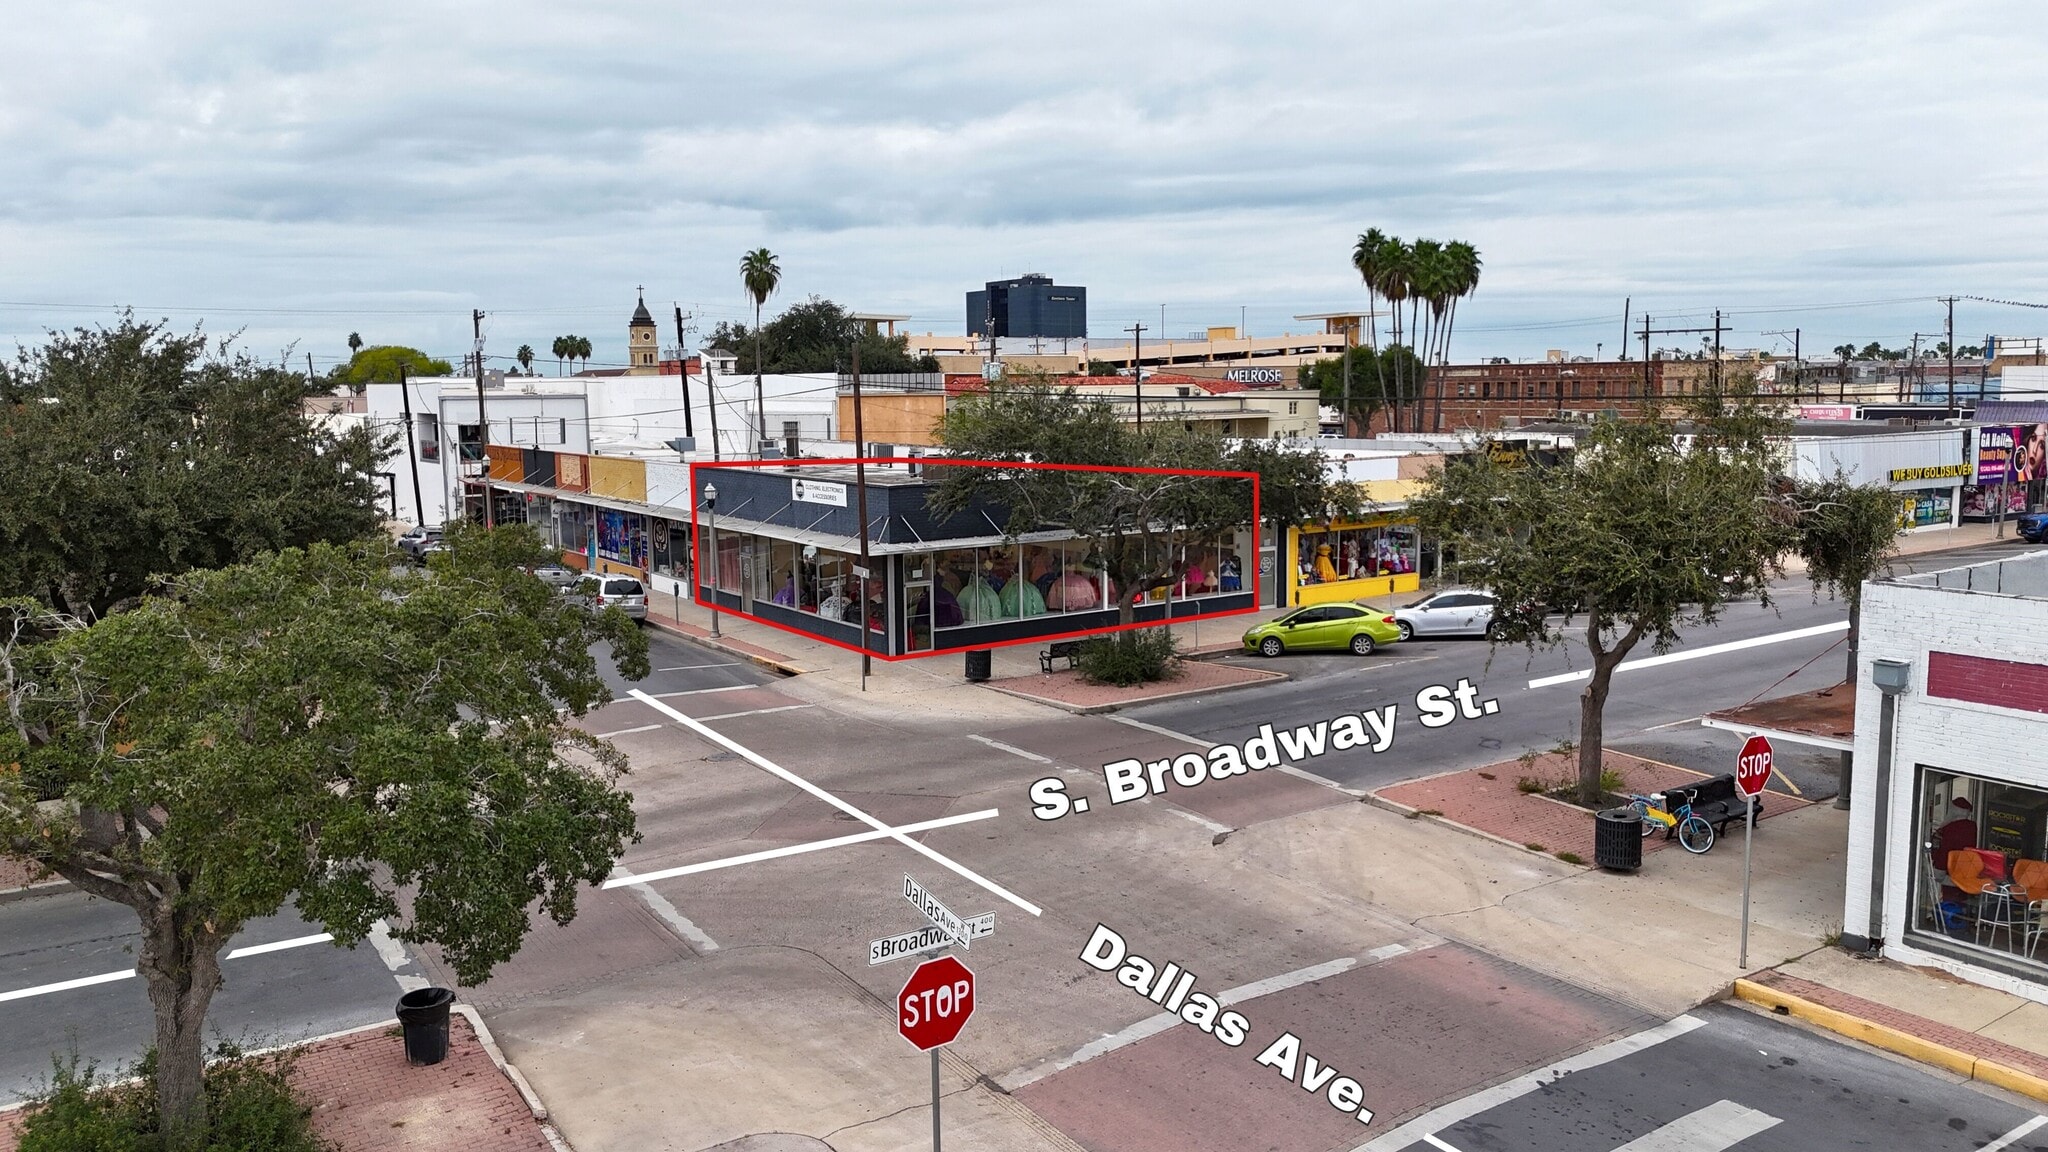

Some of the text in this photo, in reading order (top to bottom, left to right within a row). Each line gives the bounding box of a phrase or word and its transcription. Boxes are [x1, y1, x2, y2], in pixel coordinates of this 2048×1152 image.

[1227, 369, 1281, 383] MELROSE
[1981, 433, 1990, 447] GA
[1893, 469, 1905, 481] WE
[1906, 467, 1922, 480] BUY
[1739, 752, 1770, 779] STOP
[905, 878, 956, 934] Dallas Ave
[980, 916, 993, 925] 400
[872, 946, 880, 959] S
[904, 980, 970, 1028] STOP
